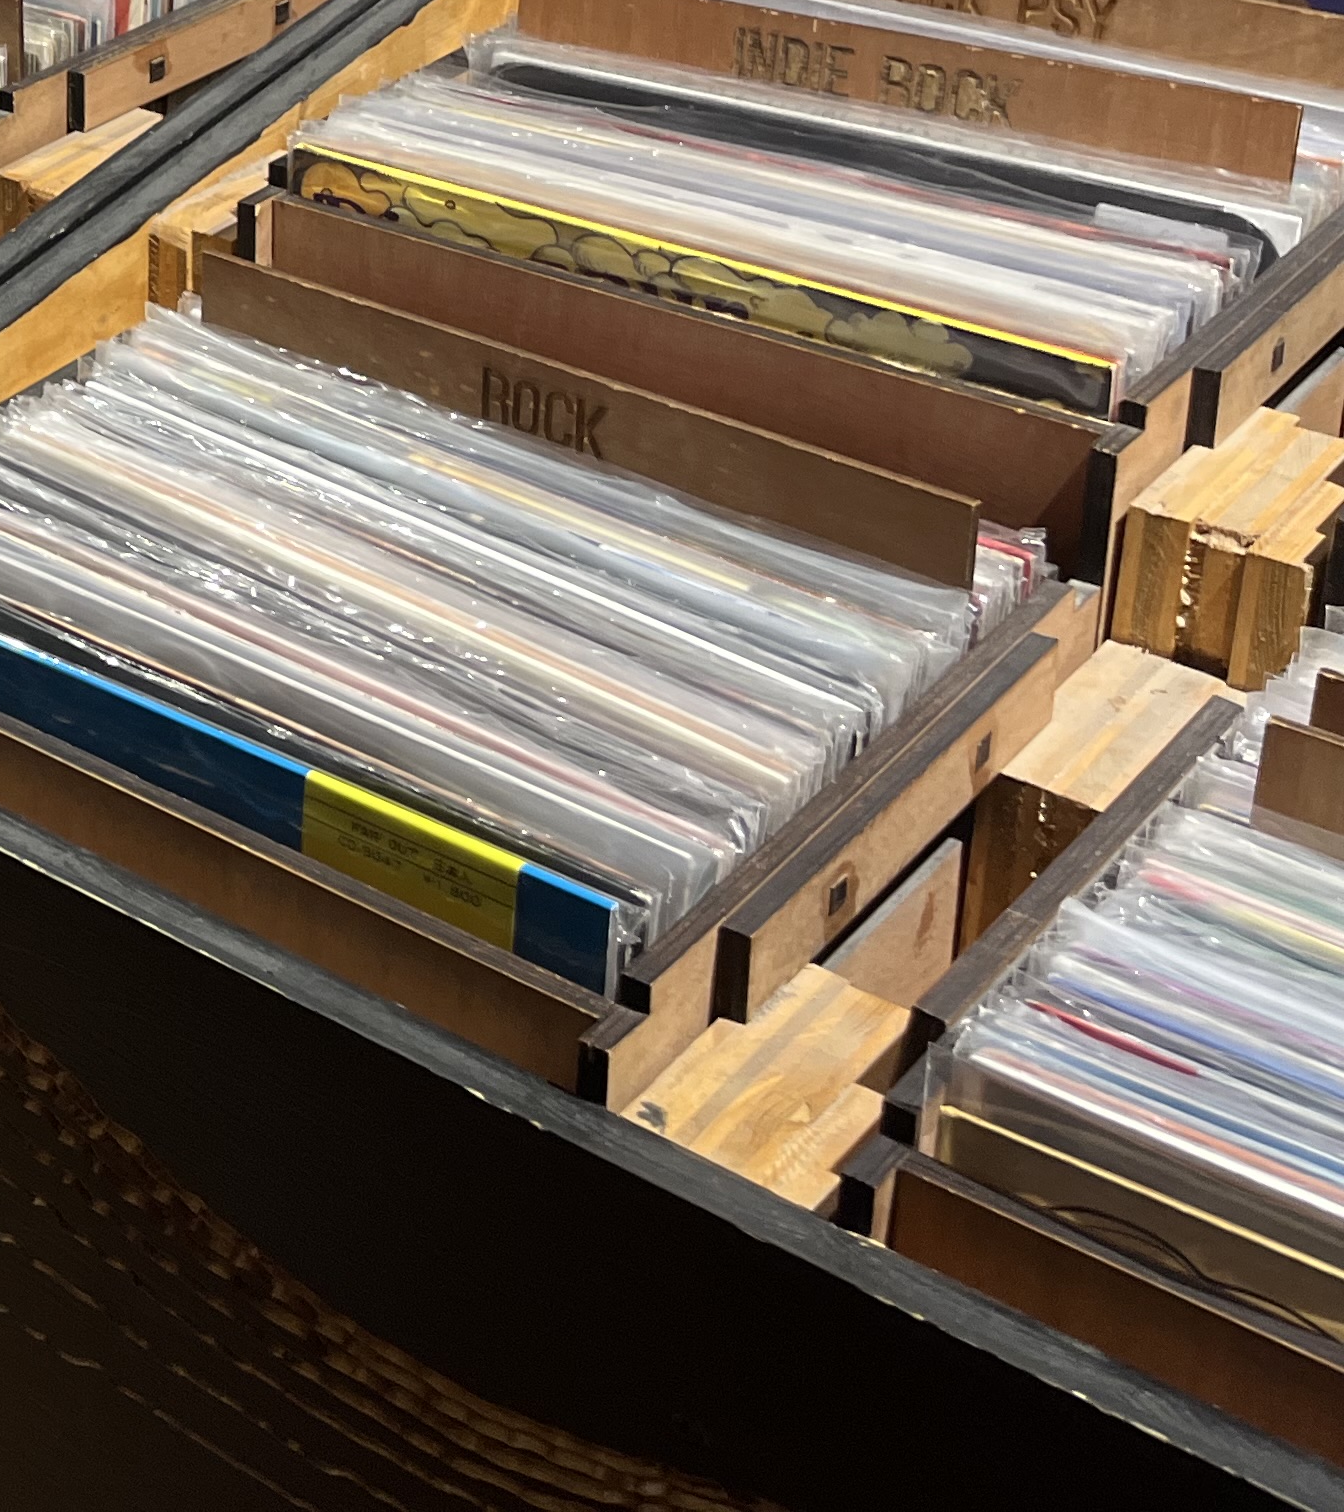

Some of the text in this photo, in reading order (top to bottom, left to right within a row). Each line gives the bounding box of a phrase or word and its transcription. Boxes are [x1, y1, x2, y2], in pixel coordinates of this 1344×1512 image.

[731, 25, 1016, 128] INDIE ROCK
[479, 365, 610, 459] ROCK
